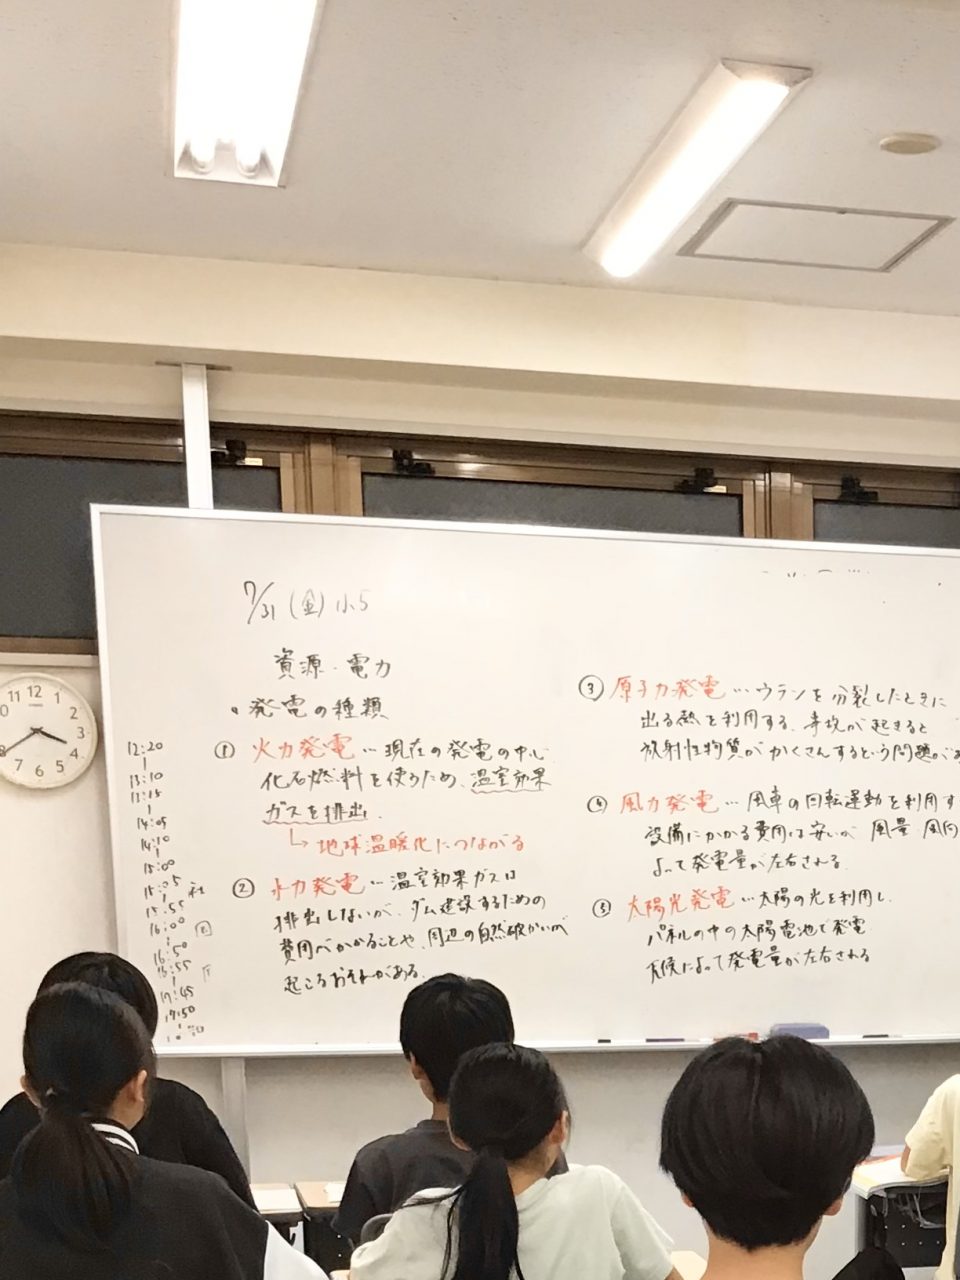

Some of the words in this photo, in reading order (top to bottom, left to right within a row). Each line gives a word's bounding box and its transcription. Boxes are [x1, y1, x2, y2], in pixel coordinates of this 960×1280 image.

[8, 690, 20, 702] 11
[27, 685, 42, 698] 12
[54, 691, 60, 704] 1
[69, 706, 79, 719] 2
[77, 726, 85, 739] 3
[69, 748, 78, 759] 4
[14, 758, 23, 771] 7
[35, 764, 44, 777] 6
[56, 760, 64, 773] 5
